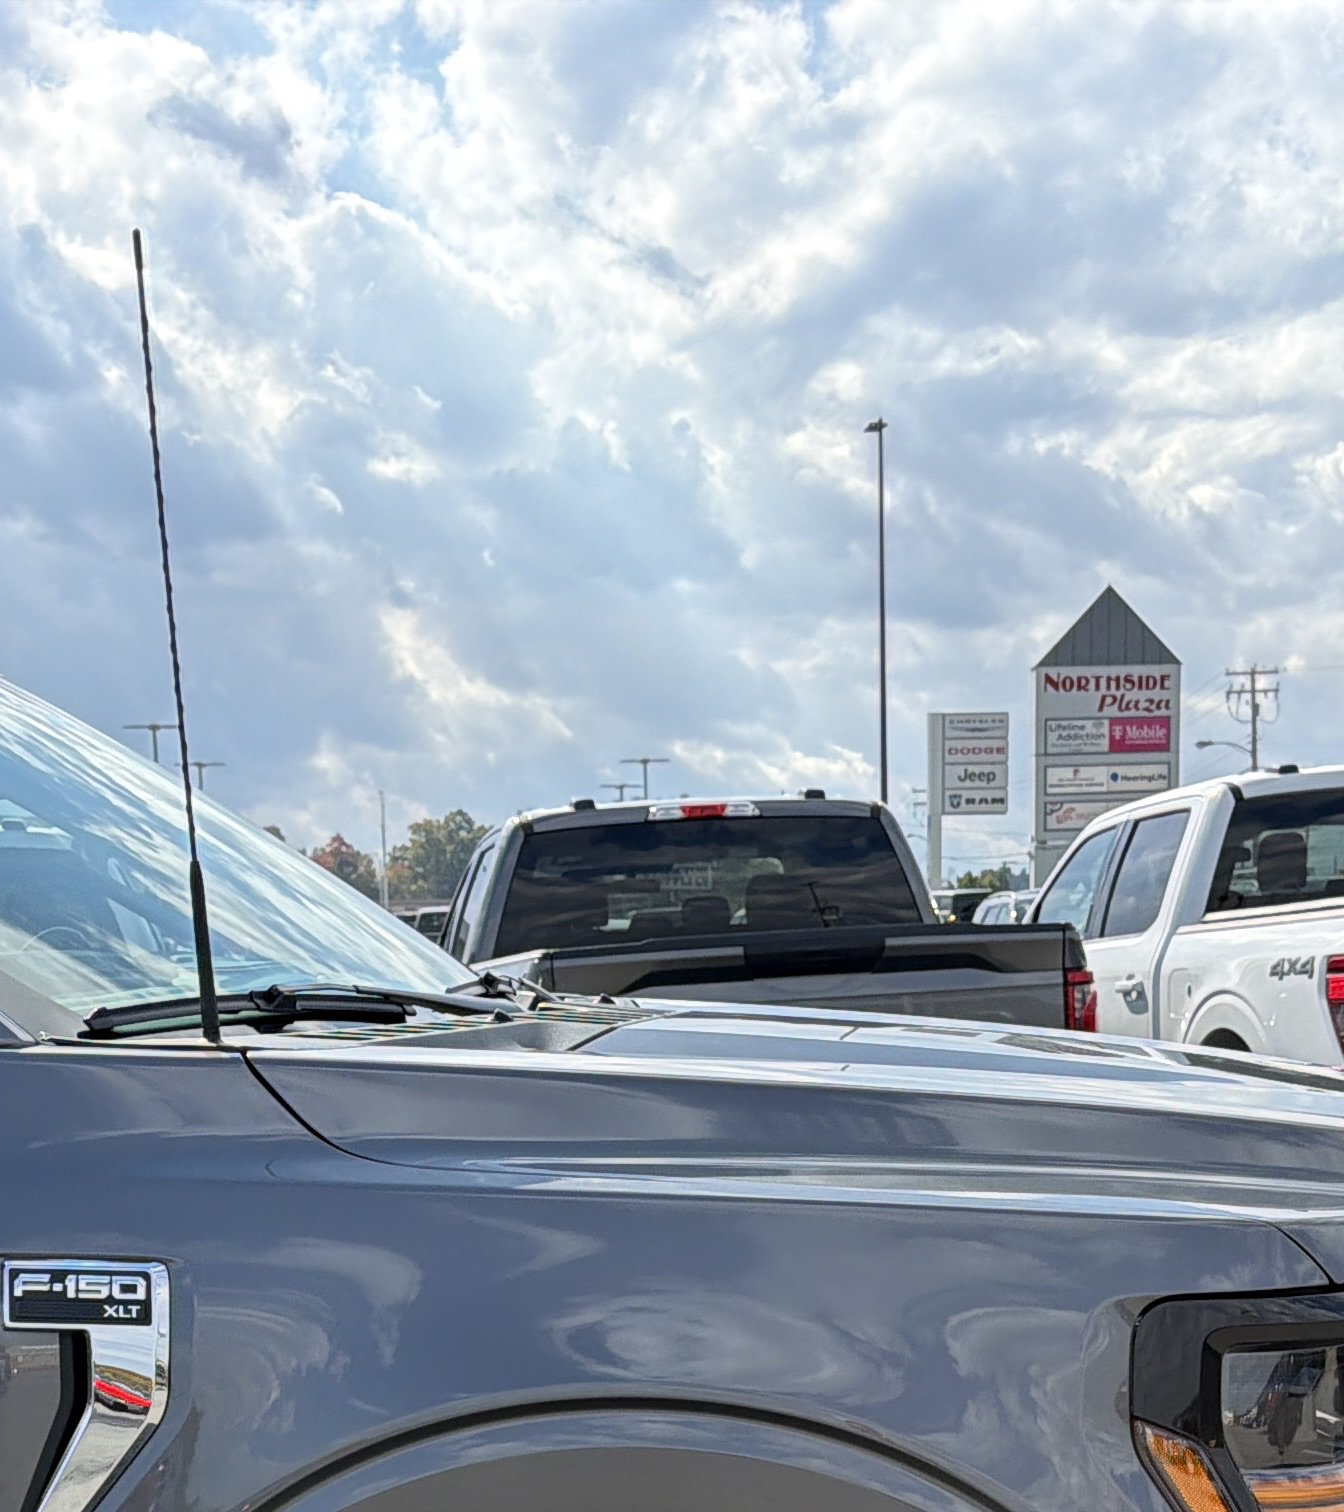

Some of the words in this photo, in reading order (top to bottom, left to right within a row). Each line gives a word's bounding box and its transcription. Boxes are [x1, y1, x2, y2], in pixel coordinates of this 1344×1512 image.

[1044, 672, 1171, 693] NORTHSIDE
[1097, 693, 1171, 713] Plaza
[947, 746, 1005, 756] DODGE
[957, 767, 997, 785] Jeep
[964, 797, 1005, 806] RAM
[13, 1273, 147, 1301] F-150
[102, 1304, 142, 1319] XLT
